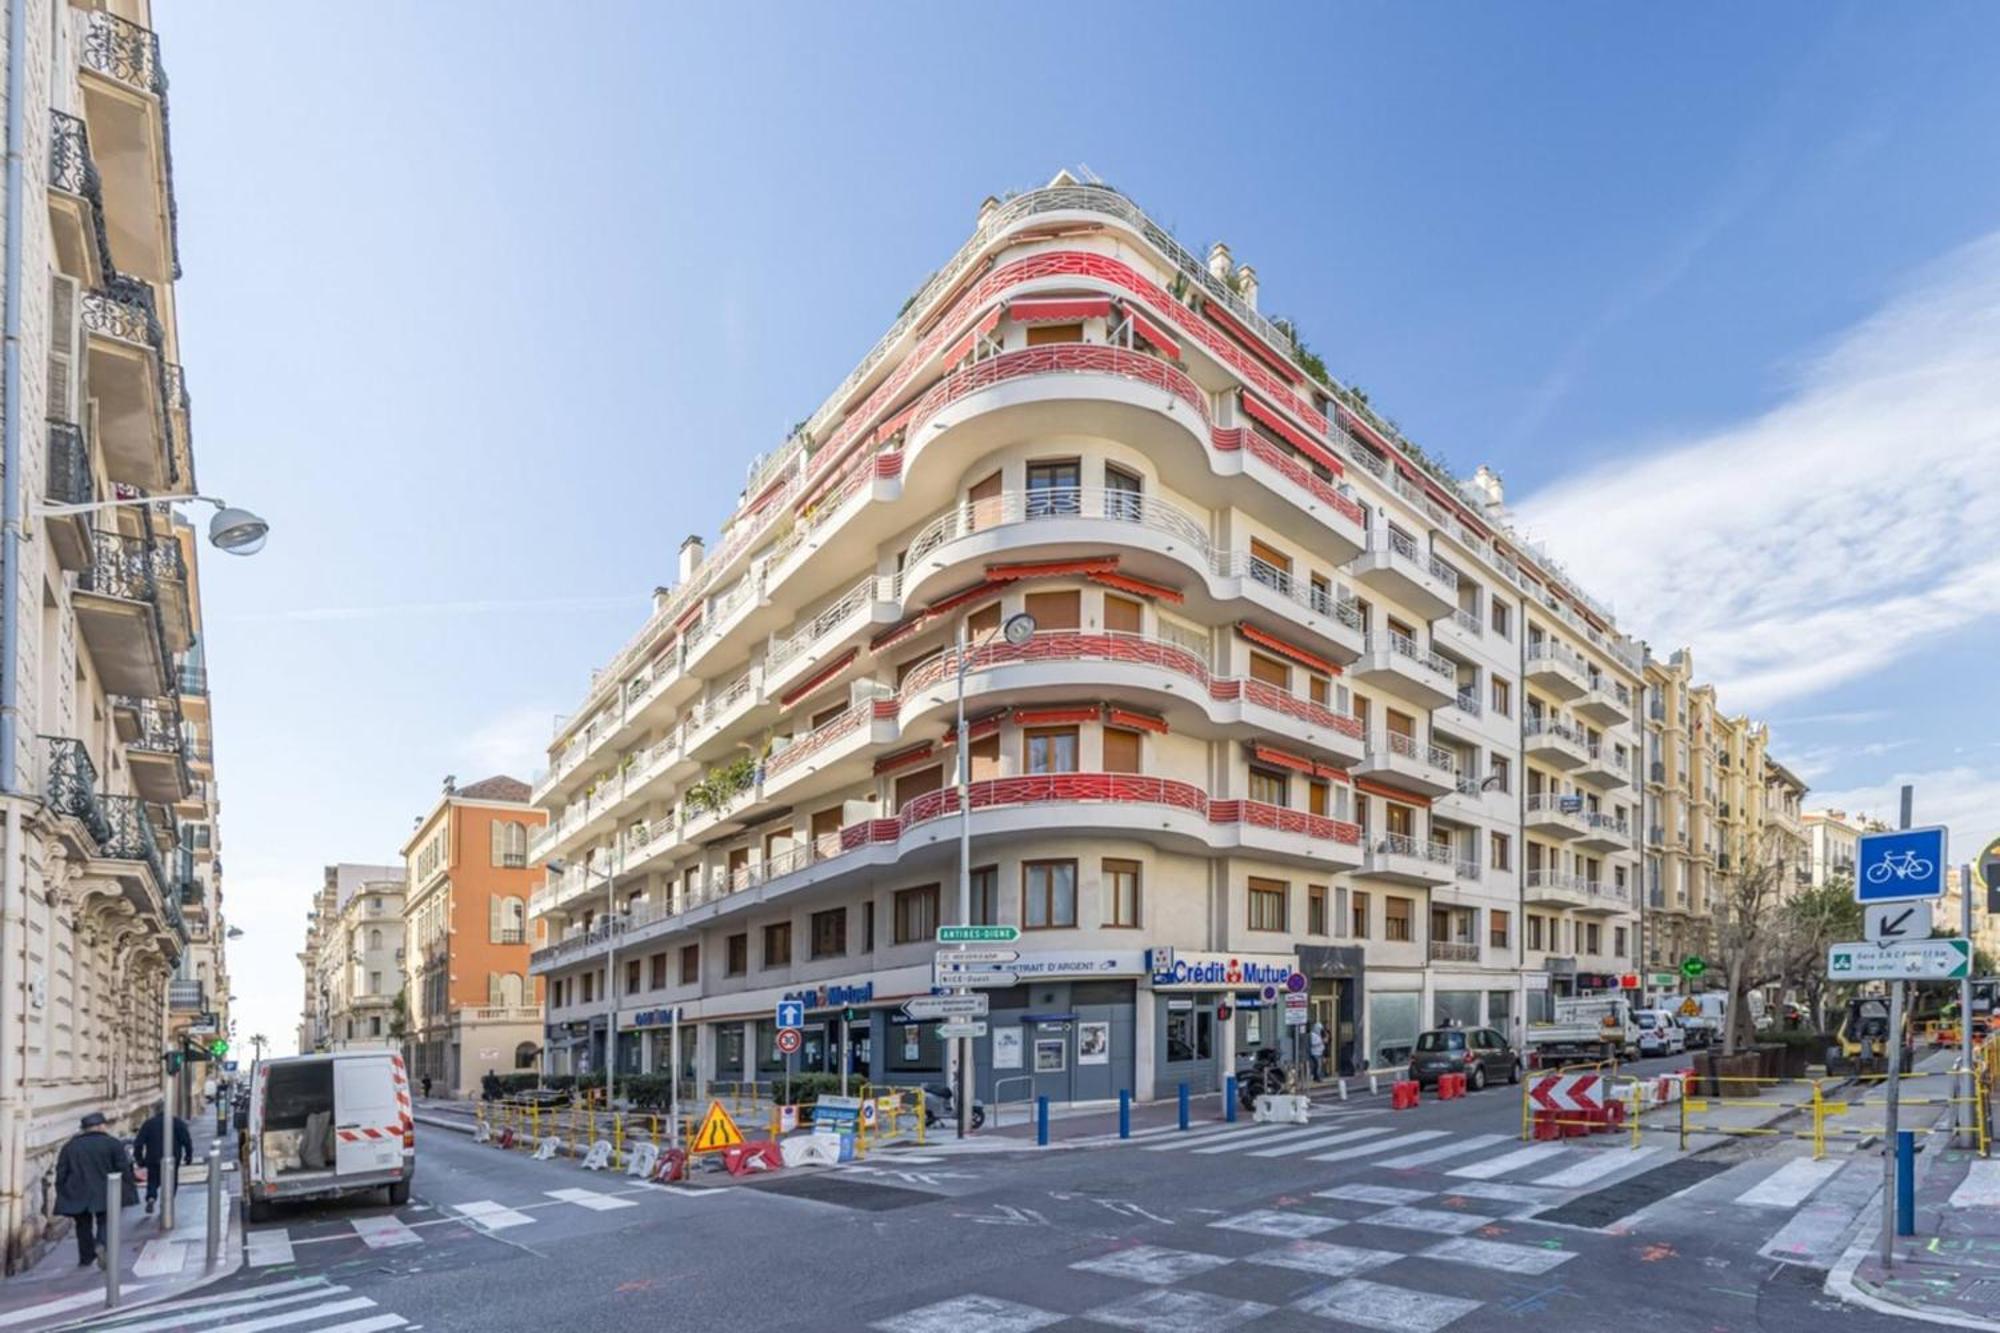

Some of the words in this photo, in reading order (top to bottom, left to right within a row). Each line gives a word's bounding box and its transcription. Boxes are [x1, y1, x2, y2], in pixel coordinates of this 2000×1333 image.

[943, 929, 1011, 939] ANTIBES-DIGNE
[1048, 962, 1094, 971] D'ARGENT
[1174, 960, 1225, 983] Crédit
[1243, 962, 1292, 983] Mutuel
